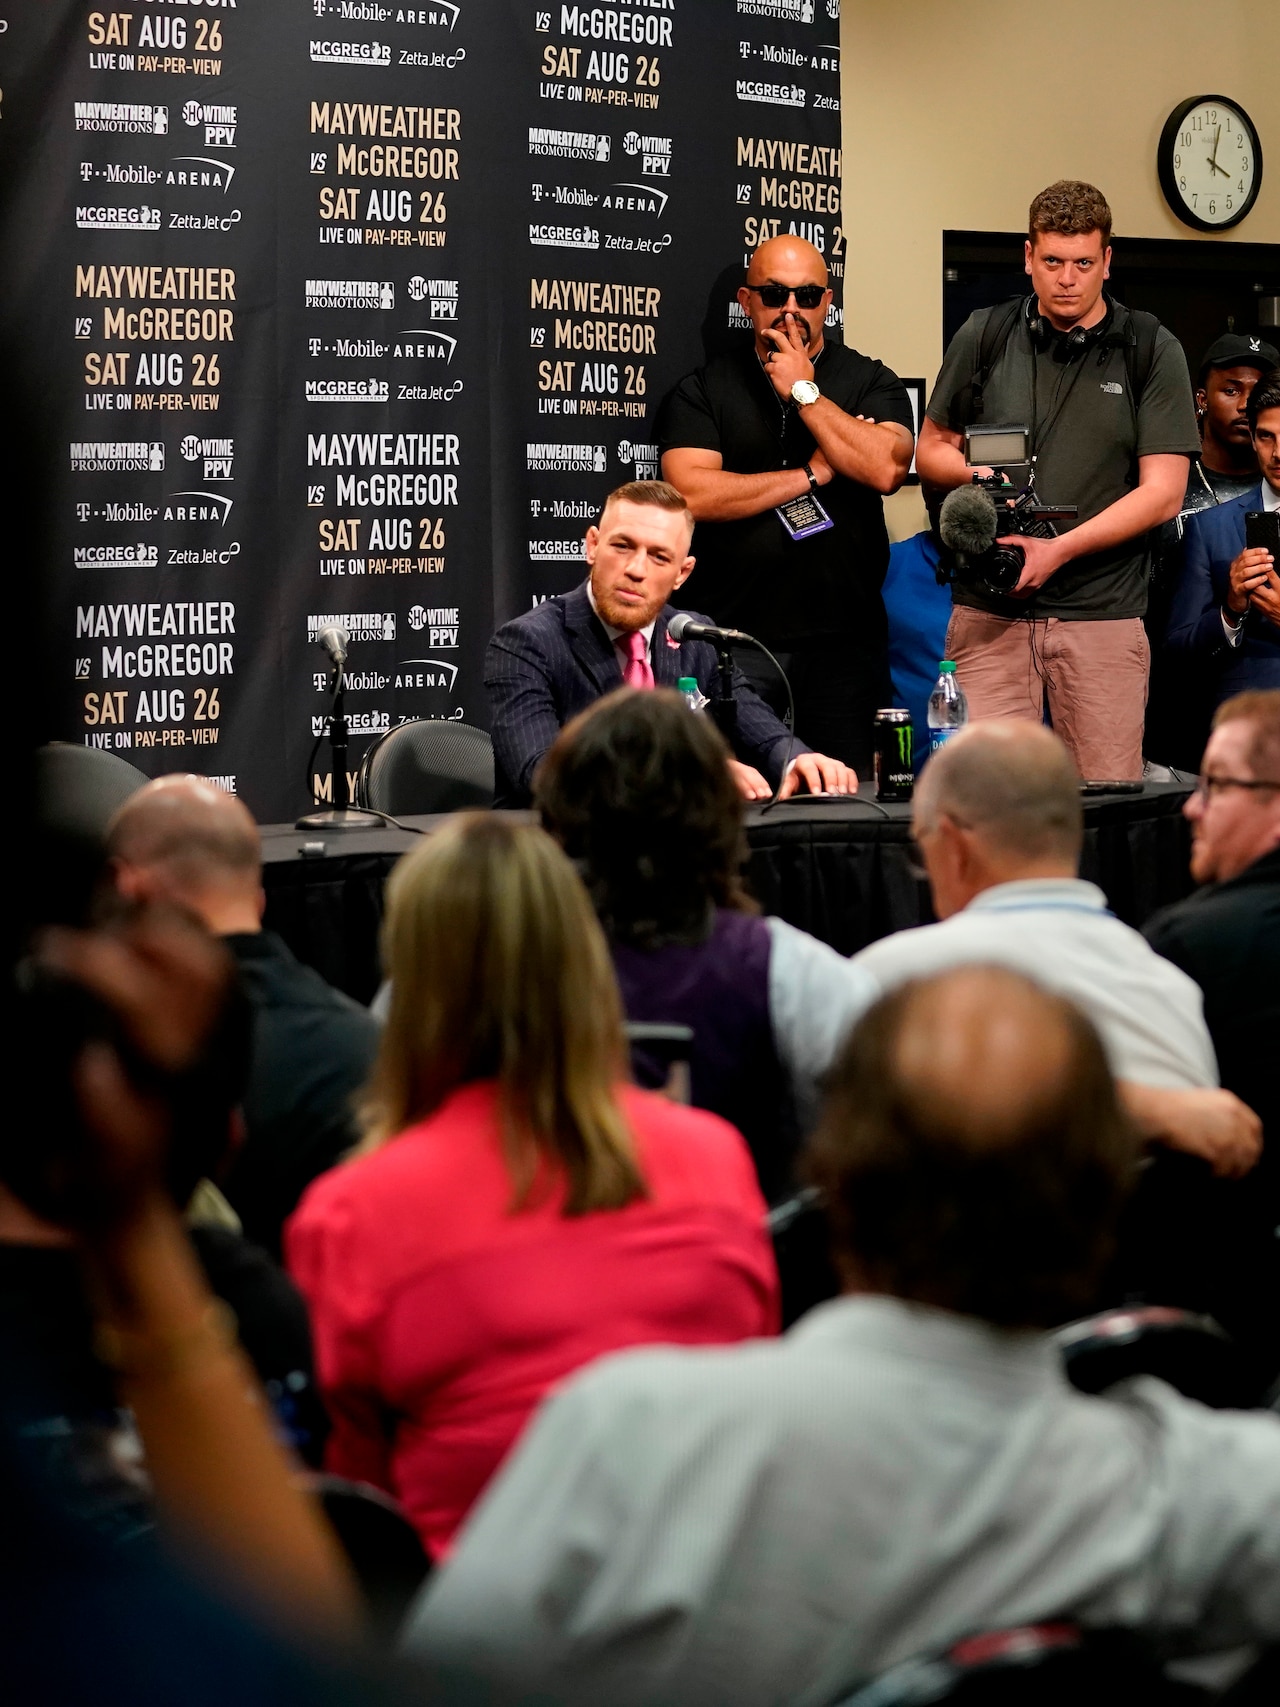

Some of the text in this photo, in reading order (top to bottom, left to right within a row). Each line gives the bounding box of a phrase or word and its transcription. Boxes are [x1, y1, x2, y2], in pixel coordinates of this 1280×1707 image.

[396, 10, 448, 26] ARENA
[737, 2, 800, 21] PROMOTIONS
[88, 12, 223, 52] SAT AUG 26
[561, 4, 672, 47] McGREGOR
[89, 53, 222, 76] LIVE ON PAY-PER-VIEW
[542, 44, 660, 87] SAT AUG 26
[811, 56, 840, 72] ARE
[540, 82, 660, 109] LIVE ON PAY-PER-VIEW
[813, 94, 840, 110] Zetta
[74, 102, 152, 121] MAYWEATHER
[182, 100, 237, 126] SHOWTIME
[310, 101, 461, 140] MAYWEATHER
[1206, 110, 1216, 124] 12
[75, 119, 152, 133] PROMOTIONS
[1192, 116, 1202, 131] 11
[1226, 118, 1231, 132] 1
[205, 126, 236, 144] PPV
[529, 128, 597, 149] MAYWEATHER
[623, 131, 672, 155] SHOWTIME
[1180, 132, 1192, 147] 10
[1238, 134, 1243, 148] 2
[529, 143, 595, 160] PROMOTIONS
[338, 144, 460, 180] McGREGOR
[643, 156, 670, 174] PPV
[1175, 154, 1181, 169] 9
[1242, 156, 1248, 171] 3
[166, 171, 222, 186] ARENA
[1180, 176, 1186, 191] 8
[1238, 179, 1244, 193] 4
[602, 196, 656, 212] ARENA
[761, 176, 842, 214] McGREG
[1192, 194, 1198, 208] 7
[1226, 195, 1232, 209] 5
[320, 187, 446, 223] SAT AUG 26
[1210, 200, 1216, 215] 6
[320, 227, 446, 246] LIVE ON PAY-PER-VIEW
[76, 265, 236, 300] MAYWEATHER
[306, 280, 379, 297] MAYWEATHER
[408, 276, 458, 300] SHOWTIME
[306, 296, 379, 309] PROMOTIONS
[530, 278, 660, 318] MAYWEATHER
[430, 300, 458, 318] PPV
[104, 307, 234, 341] McGREGOR
[555, 318, 656, 354] McGREGOR
[393, 345, 446, 358] ARENA
[84, 352, 220, 386] SAT AUG 26
[538, 360, 646, 396] SAT AUG 26
[86, 394, 220, 410] LIVE ON PAY-PER-VIEW
[538, 398, 646, 418] LIVE ON PAY-PER-VIEW
[70, 442, 148, 459] MAYWEATHER
[180, 435, 234, 461] SHOWTIME
[308, 434, 460, 466] MAYWEATHER
[527, 444, 592, 460] MAYWEATHER
[618, 440, 659, 464] SHOWTIME
[70, 459, 149, 471] PROMOTIONS
[204, 461, 232, 478] PPV
[527, 459, 592, 472] PROMOTIONS
[636, 465, 658, 480] PPV
[337, 474, 458, 506] McGREGOR
[164, 507, 220, 521] ARENA
[319, 518, 445, 551] SAT AUG 26
[320, 557, 445, 576] LIVE ON PAY-PER-VIEW
[76, 602, 236, 638] MAYWEATHER
[408, 605, 460, 630] SHOWTIME
[430, 628, 458, 646] PPV
[102, 643, 234, 678] McGREGOR
[395, 674, 447, 688] ARENA
[84, 688, 220, 725] SAT AUG 26
[84, 728, 220, 749] LIVE ON PAY-PER-VIEW
